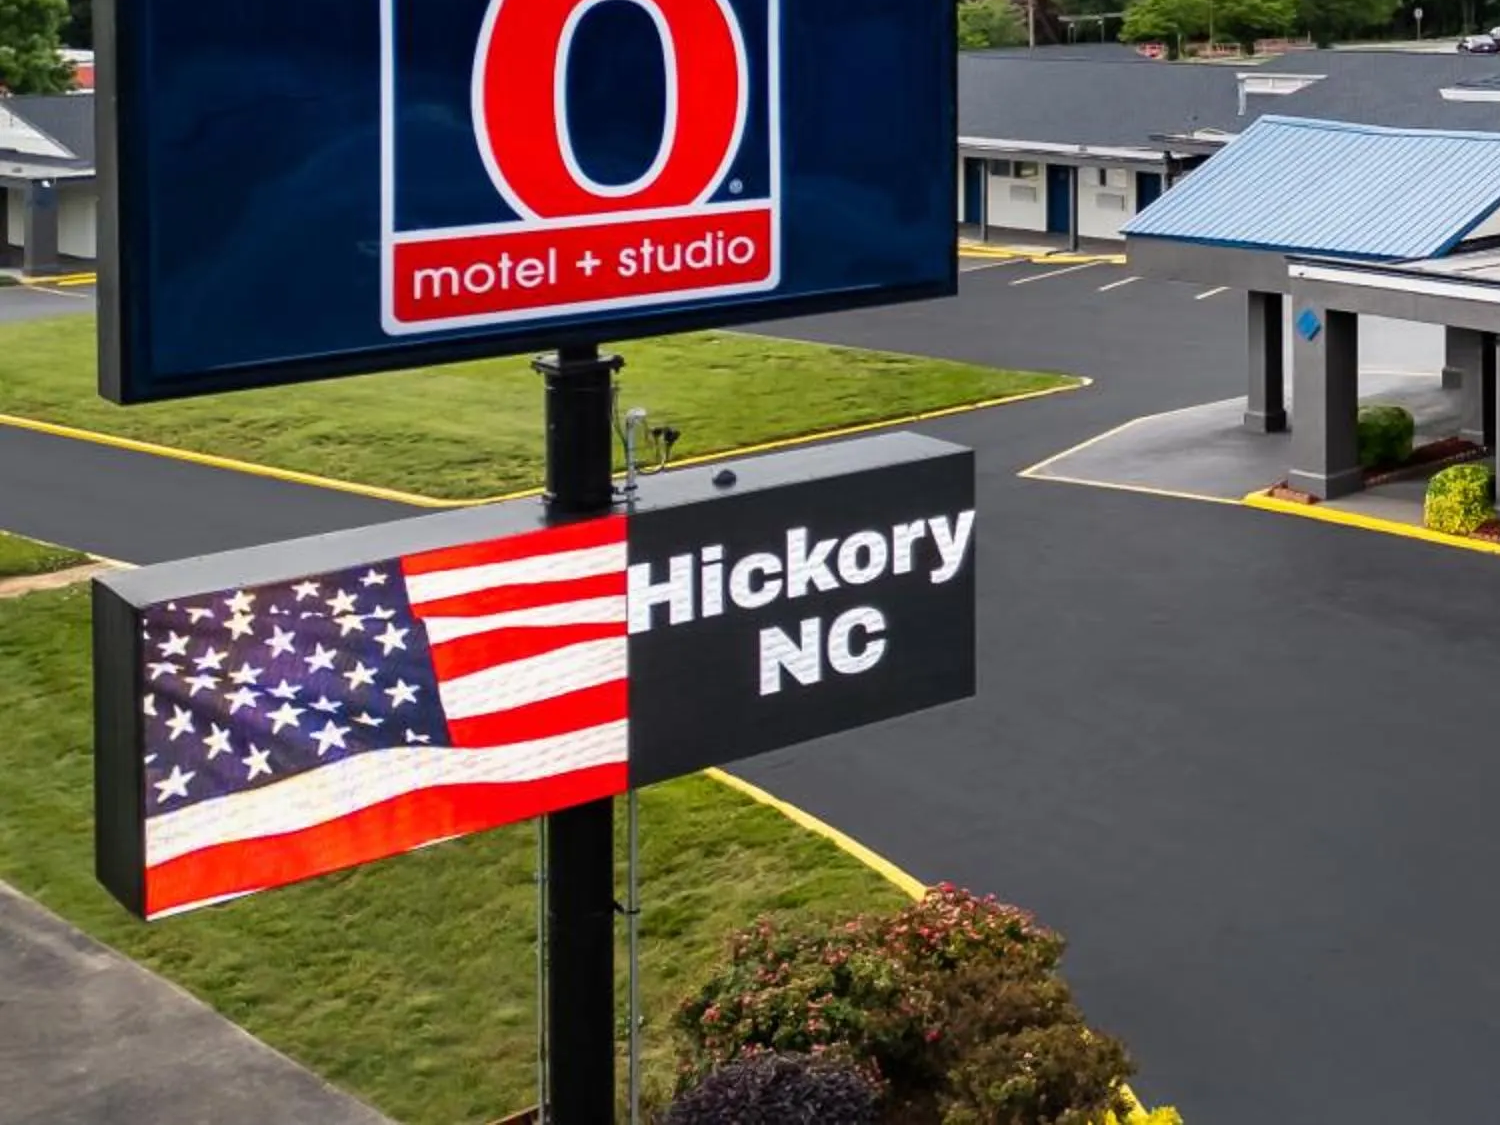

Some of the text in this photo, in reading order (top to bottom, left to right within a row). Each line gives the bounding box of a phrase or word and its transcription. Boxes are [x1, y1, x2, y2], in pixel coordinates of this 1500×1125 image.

[412, 247, 557, 300] motel
[617, 229, 755, 277] studio
[627, 510, 976, 635] Hickory
[759, 606, 888, 697] NC
